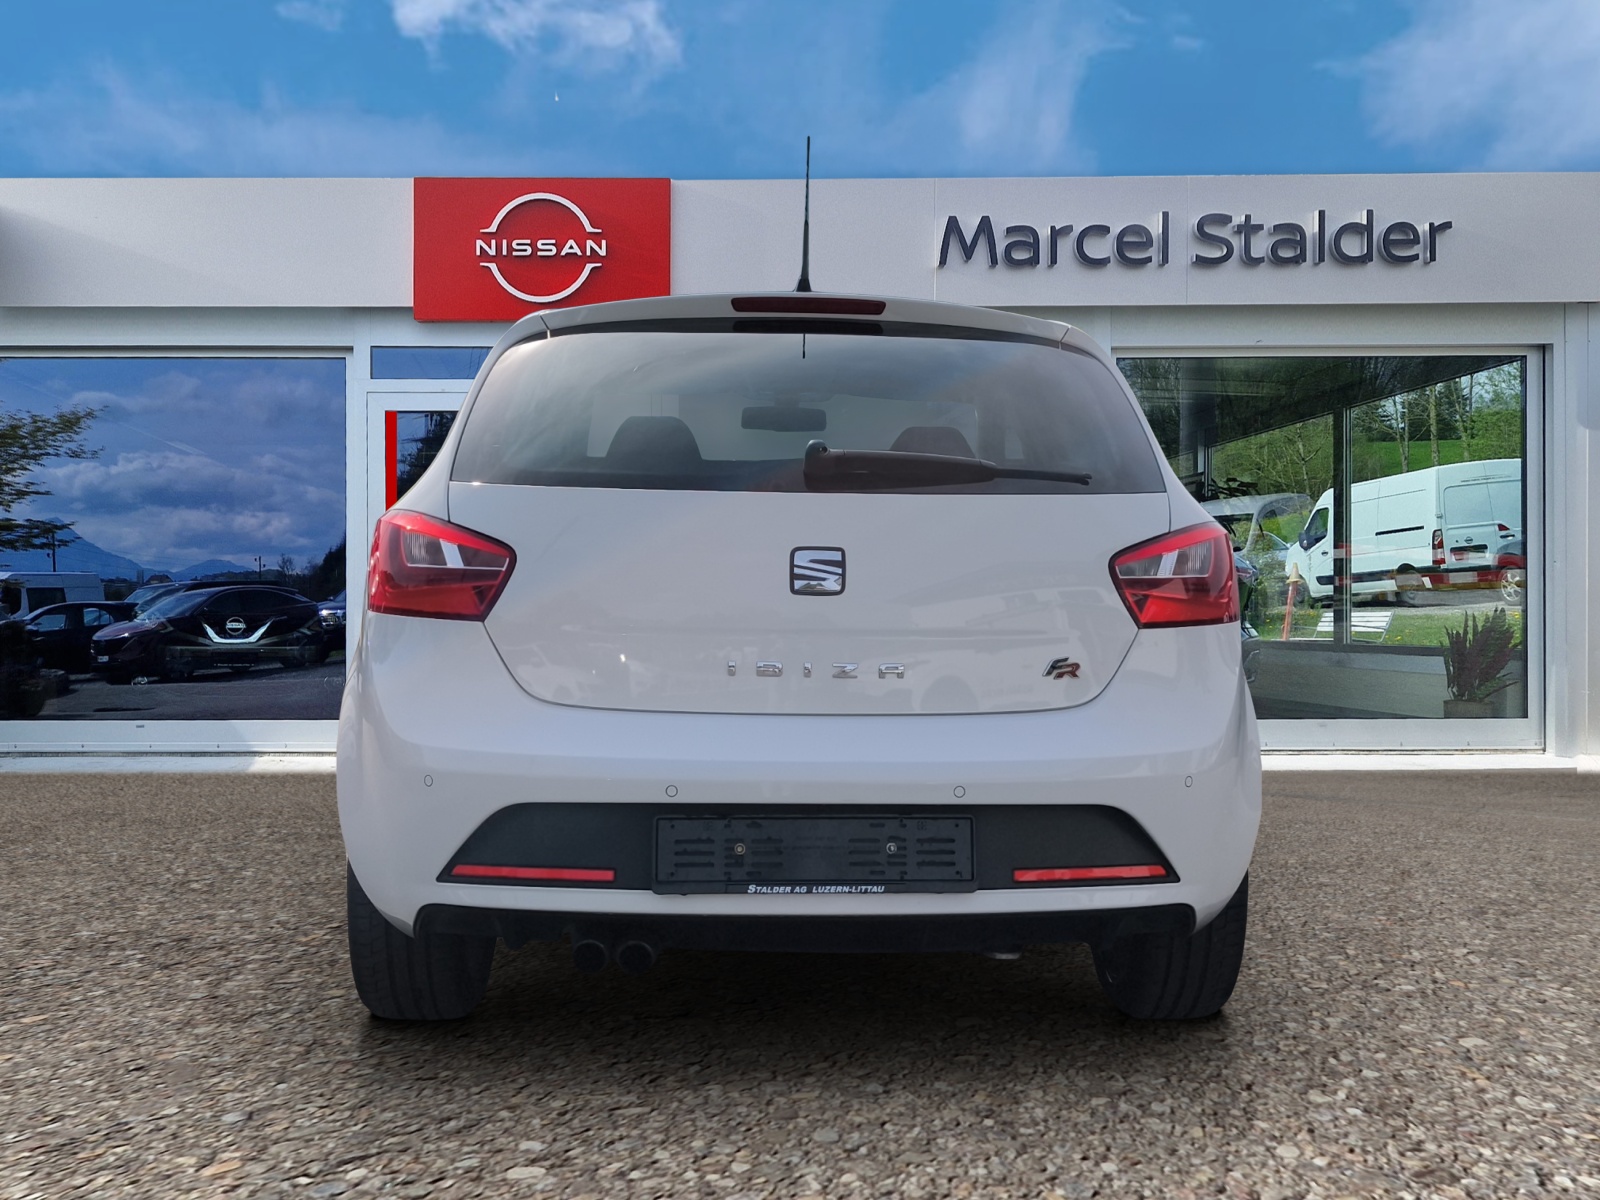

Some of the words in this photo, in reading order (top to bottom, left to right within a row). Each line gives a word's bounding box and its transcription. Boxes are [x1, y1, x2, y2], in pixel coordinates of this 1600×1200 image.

[475, 239, 607, 257] NISSAN
[937, 210, 1170, 269] Marcel
[1191, 208, 1453, 267] Stalder
[1042, 656, 1082, 681] FR
[747, 884, 791, 894] STALDER
[793, 885, 807, 893] AG
[812, 885, 885, 893] LUZERN-LITTAU
